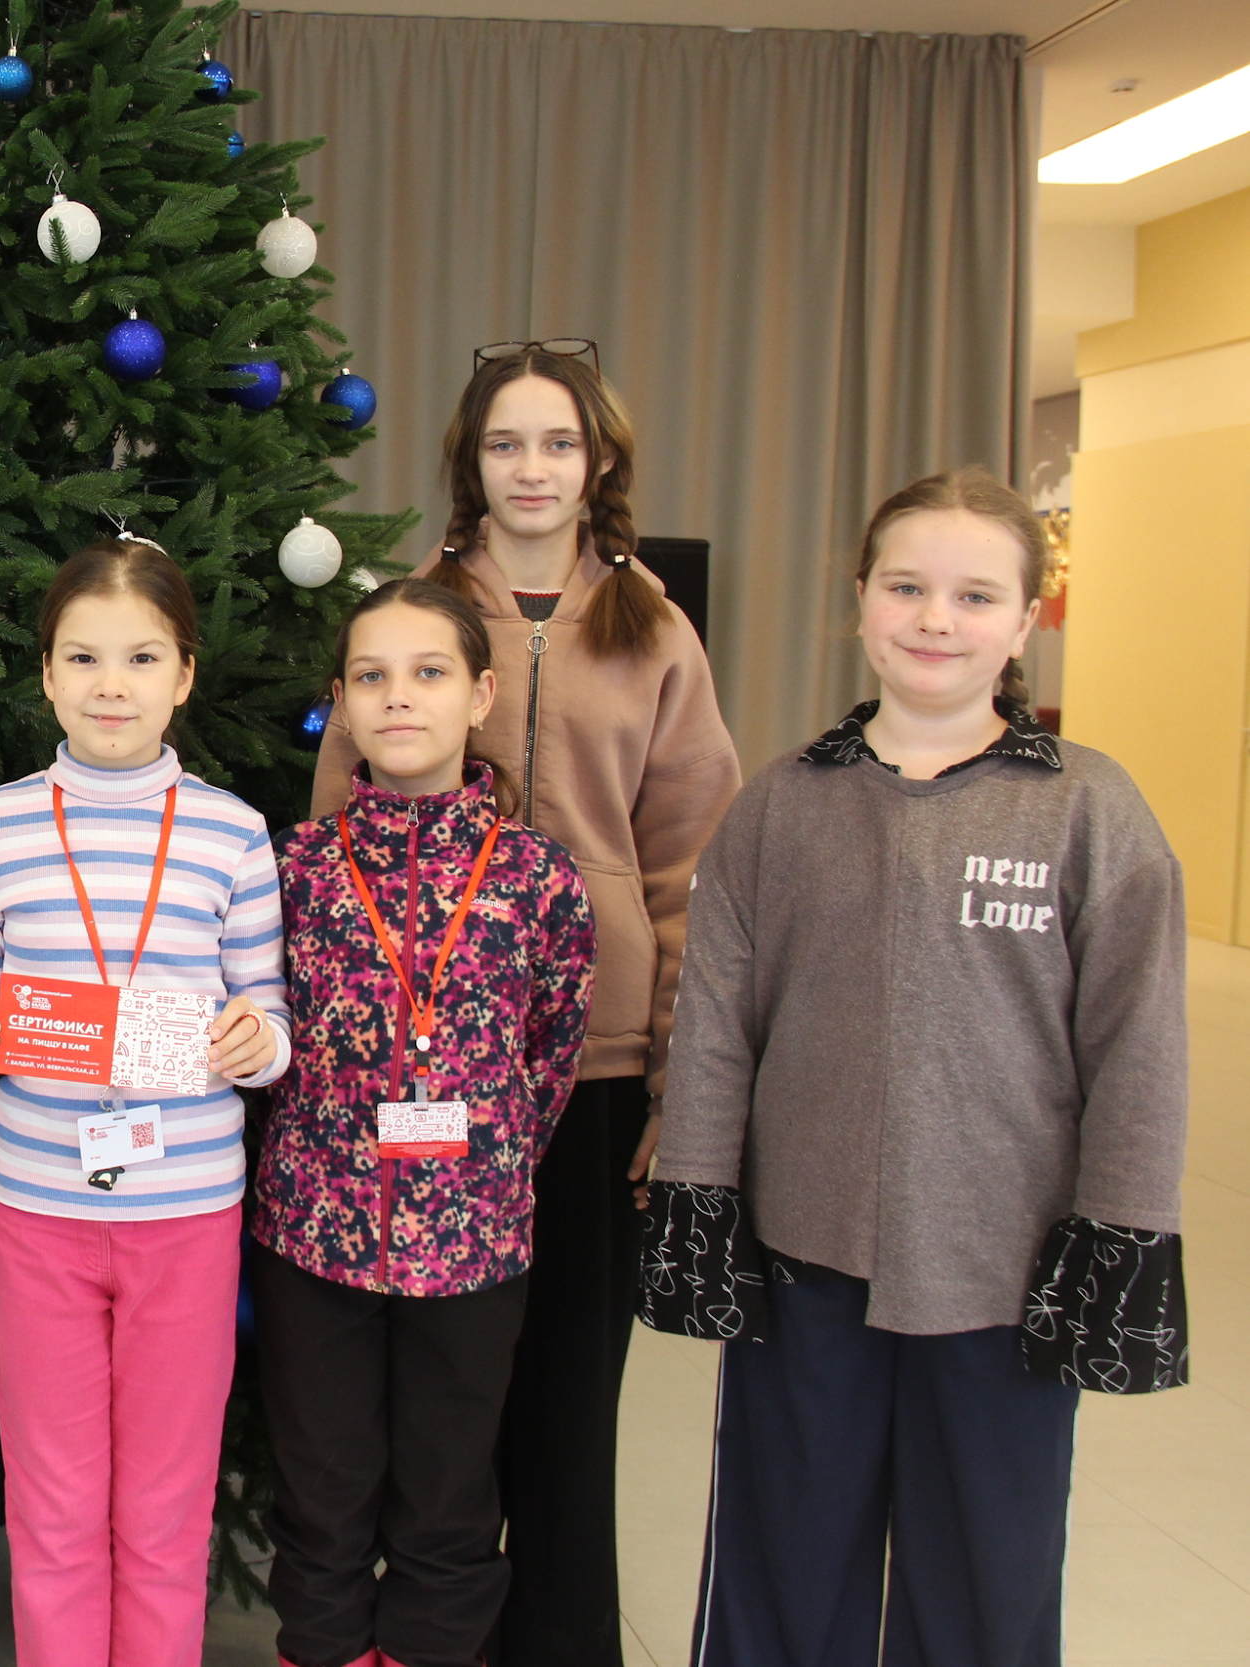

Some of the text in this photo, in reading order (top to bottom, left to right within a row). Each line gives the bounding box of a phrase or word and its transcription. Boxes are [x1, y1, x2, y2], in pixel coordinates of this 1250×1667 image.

[963, 855, 1049, 888] new
[8, 1014, 104, 1035] СЕРТИФИКАТ
[32, 1039, 61, 1048] ПИЦЦУ
[68, 1043, 90, 1051] КАФЕ
